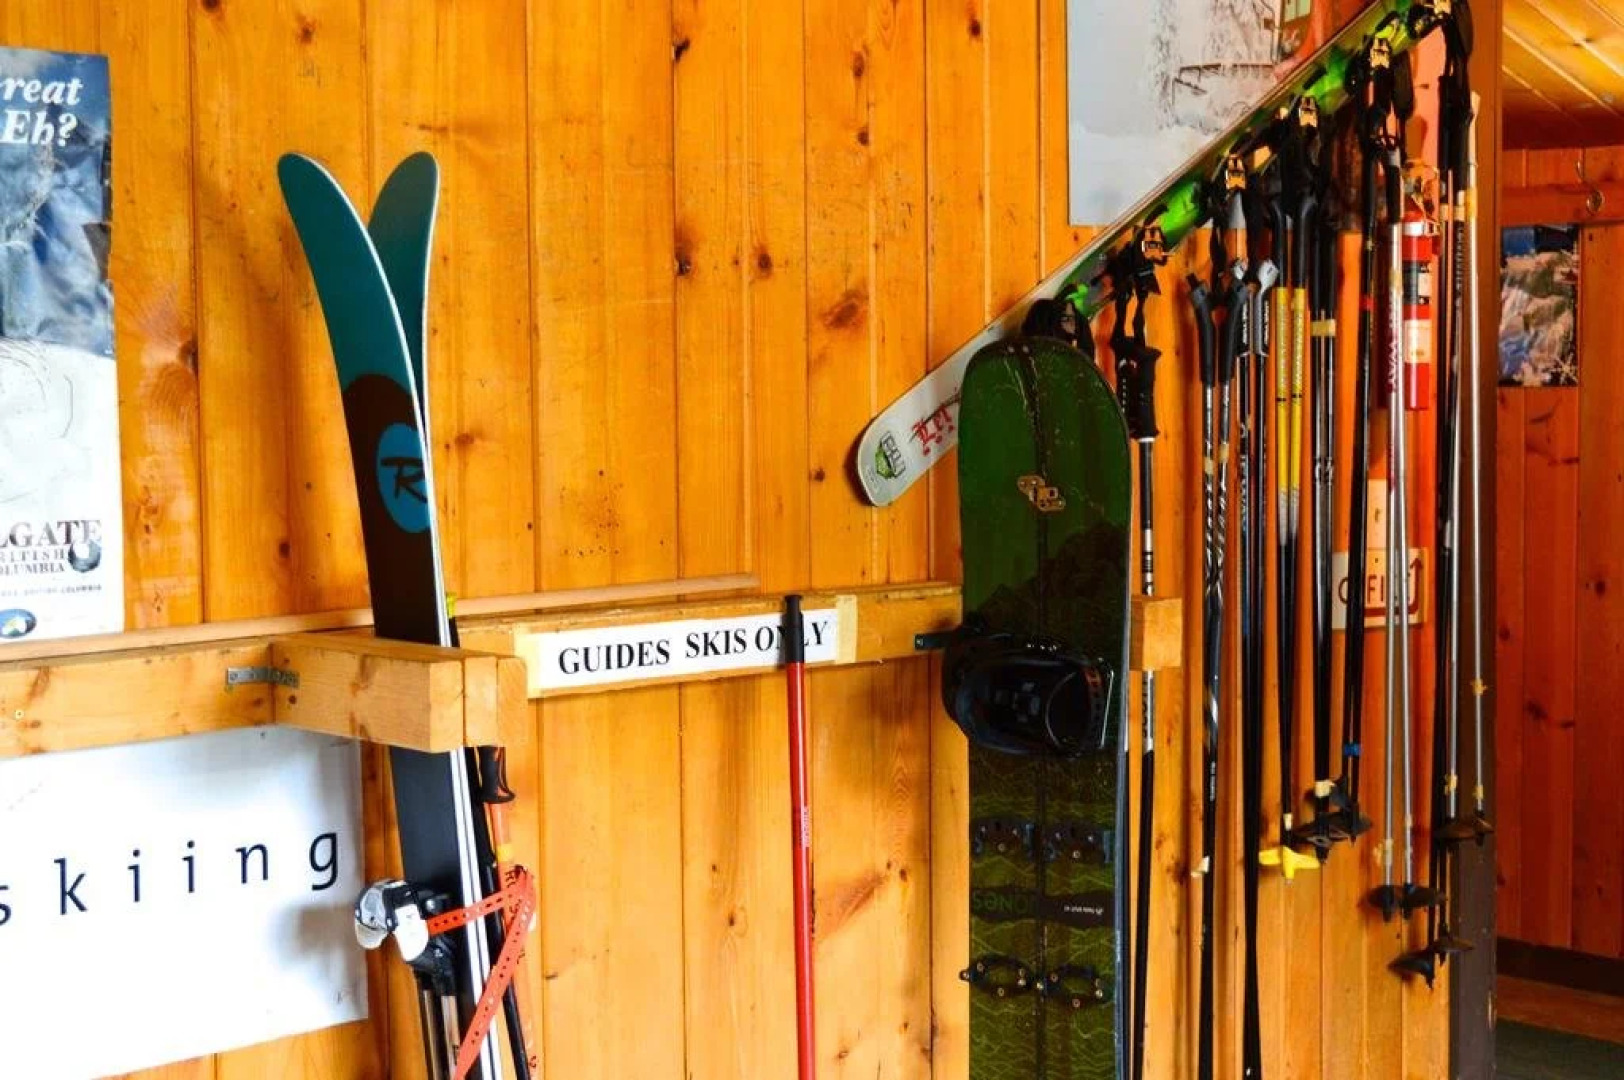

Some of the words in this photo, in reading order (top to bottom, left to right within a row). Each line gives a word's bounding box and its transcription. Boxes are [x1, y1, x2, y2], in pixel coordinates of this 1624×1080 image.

[0, 109, 77, 147] Eh?
[558, 639, 670, 674] GUIDES
[685, 628, 747, 659] SKIS
[754, 620, 829, 651] OY
[0, 832, 339, 926] skiing
